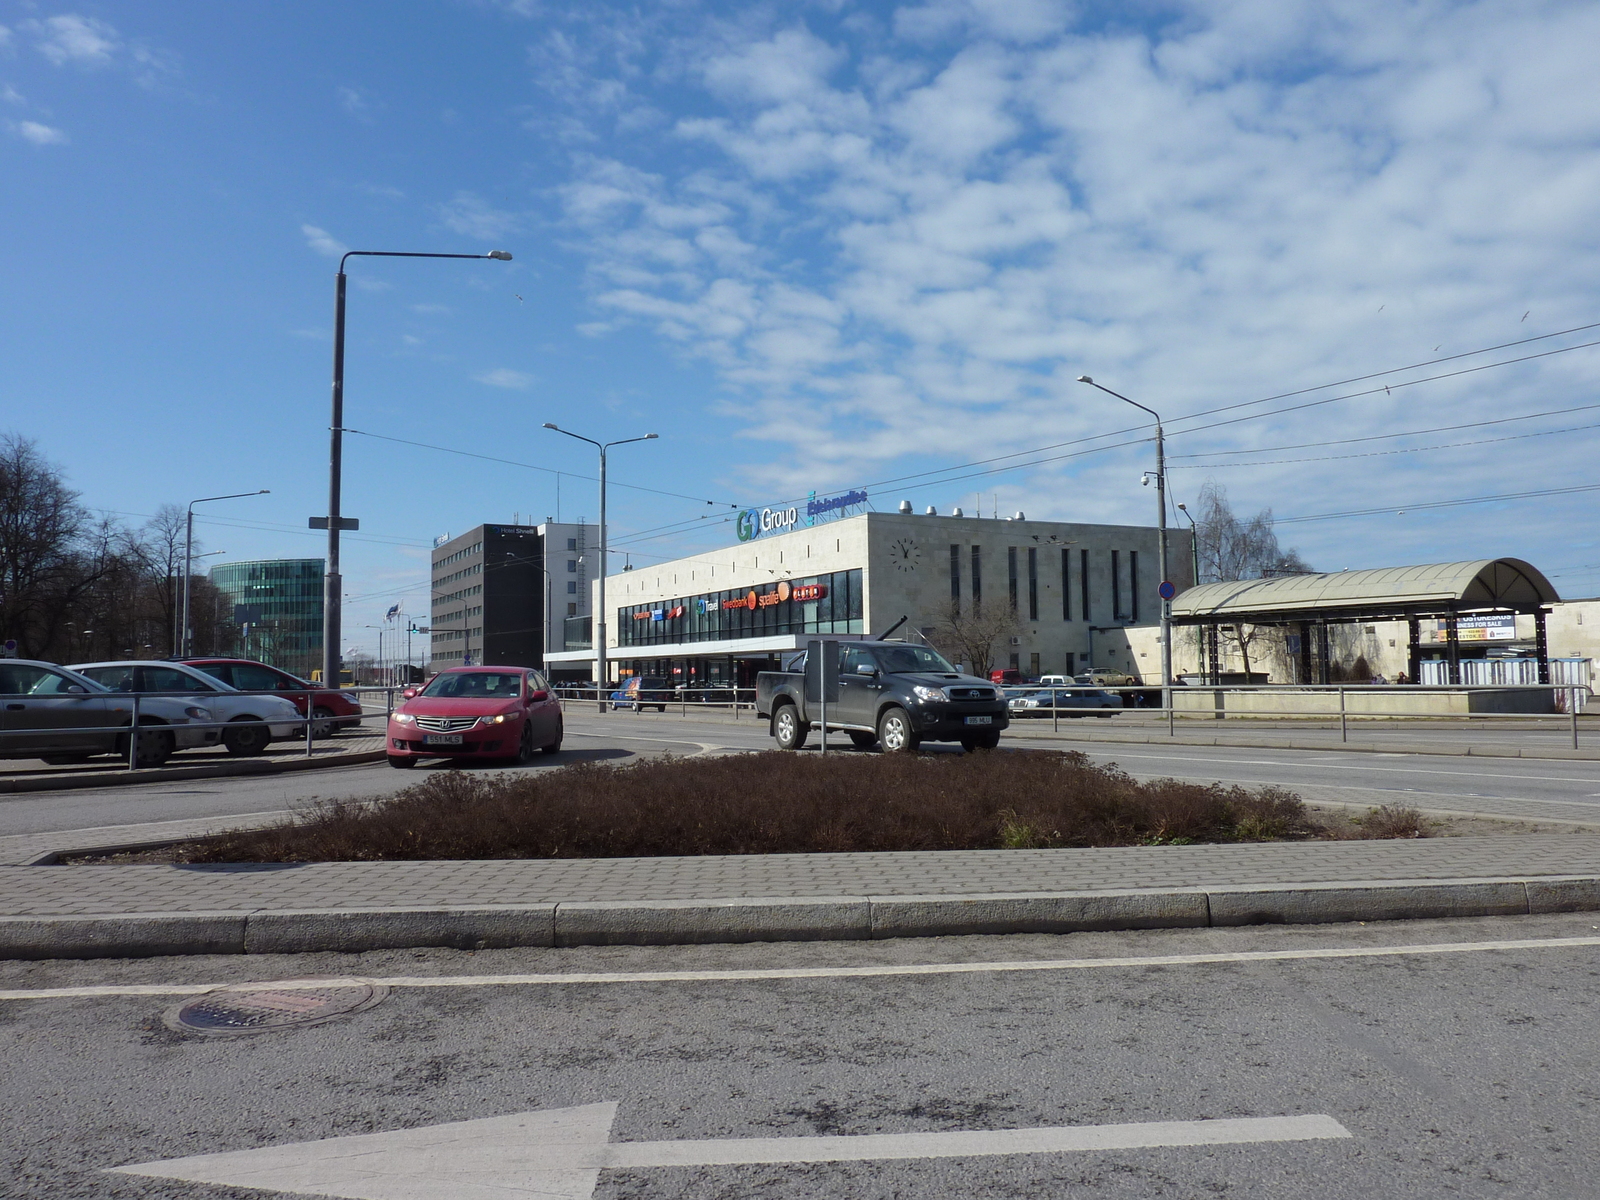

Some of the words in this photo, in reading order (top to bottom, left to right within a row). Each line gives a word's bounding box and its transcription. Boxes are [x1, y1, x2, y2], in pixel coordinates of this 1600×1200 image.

[762, 507, 798, 531] Group
[705, 599, 718, 612] Travel
[722, 596, 748, 609] Swedbank
[430, 735, 442, 743] 551
